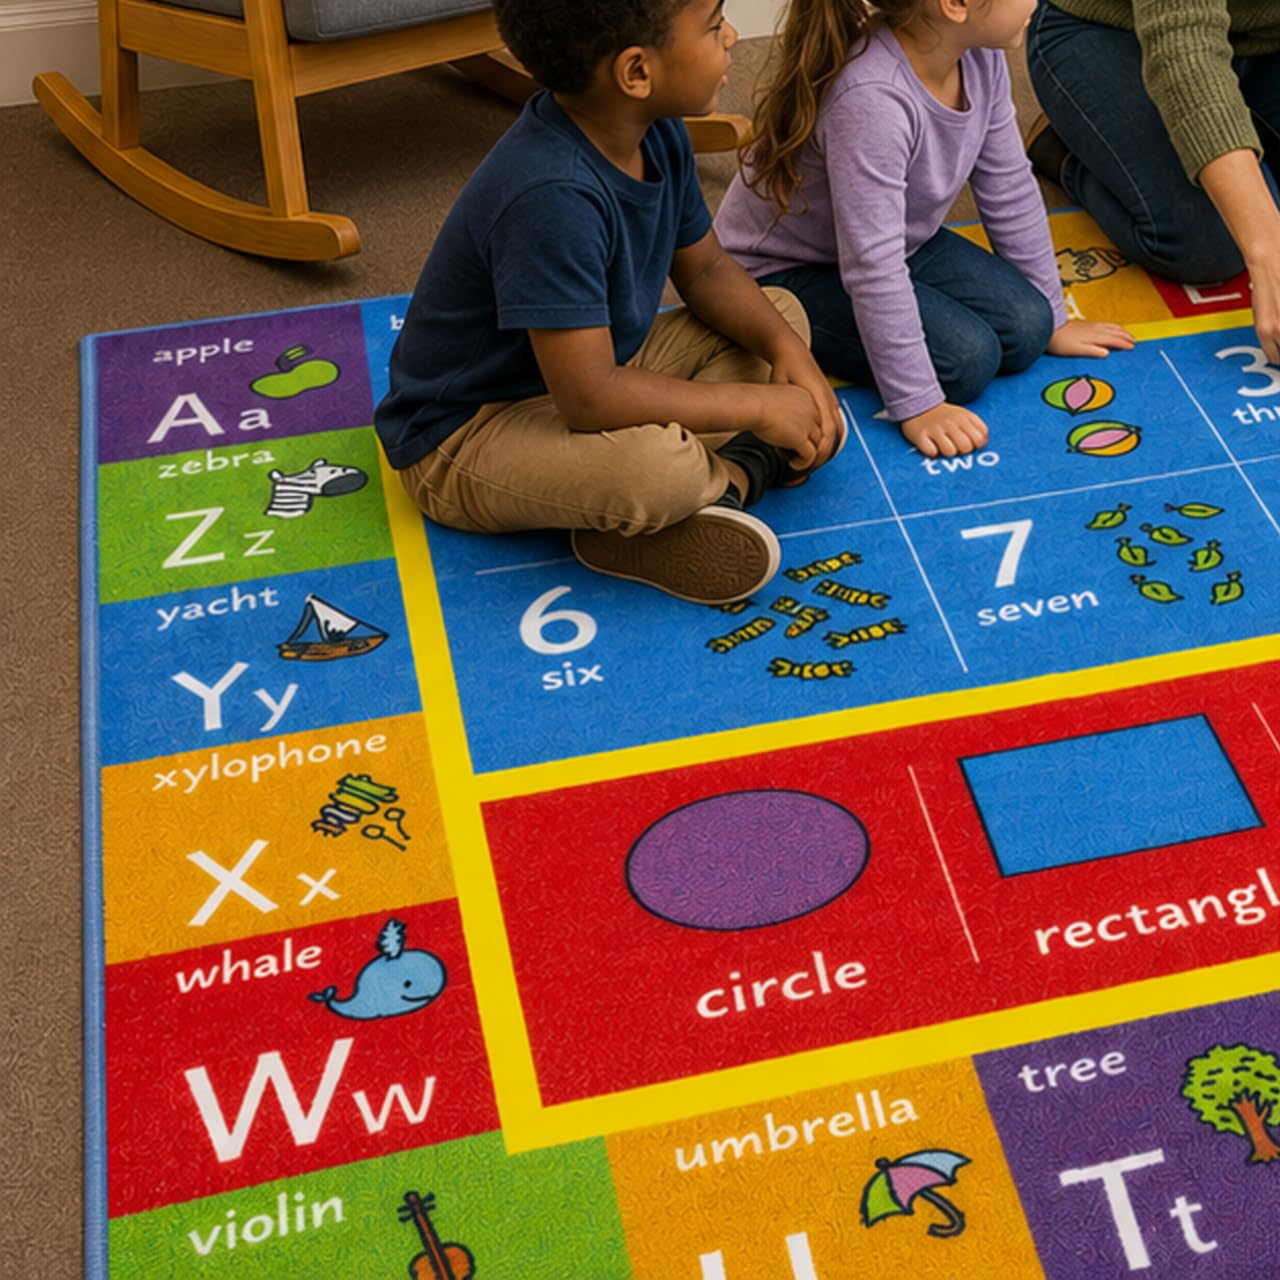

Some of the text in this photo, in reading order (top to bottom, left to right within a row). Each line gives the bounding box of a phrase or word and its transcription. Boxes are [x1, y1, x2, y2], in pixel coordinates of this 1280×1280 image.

[154, 338, 253, 365] apple
[158, 447, 276, 480] zebra
[921, 455, 1000, 475] two
[961, 519, 1032, 587] 7
[157, 587, 278, 630] yacht
[520, 587, 596, 654] 6
[976, 586, 1100, 627] seven
[543, 662, 603, 690] six
[152, 733, 387, 794] xylophone
[177, 938, 321, 992] whale
[697, 952, 865, 1017] circle
[1018, 1052, 1126, 1092] tree
[674, 1089, 920, 1172] umbrella
[189, 1192, 343, 1255] violin
